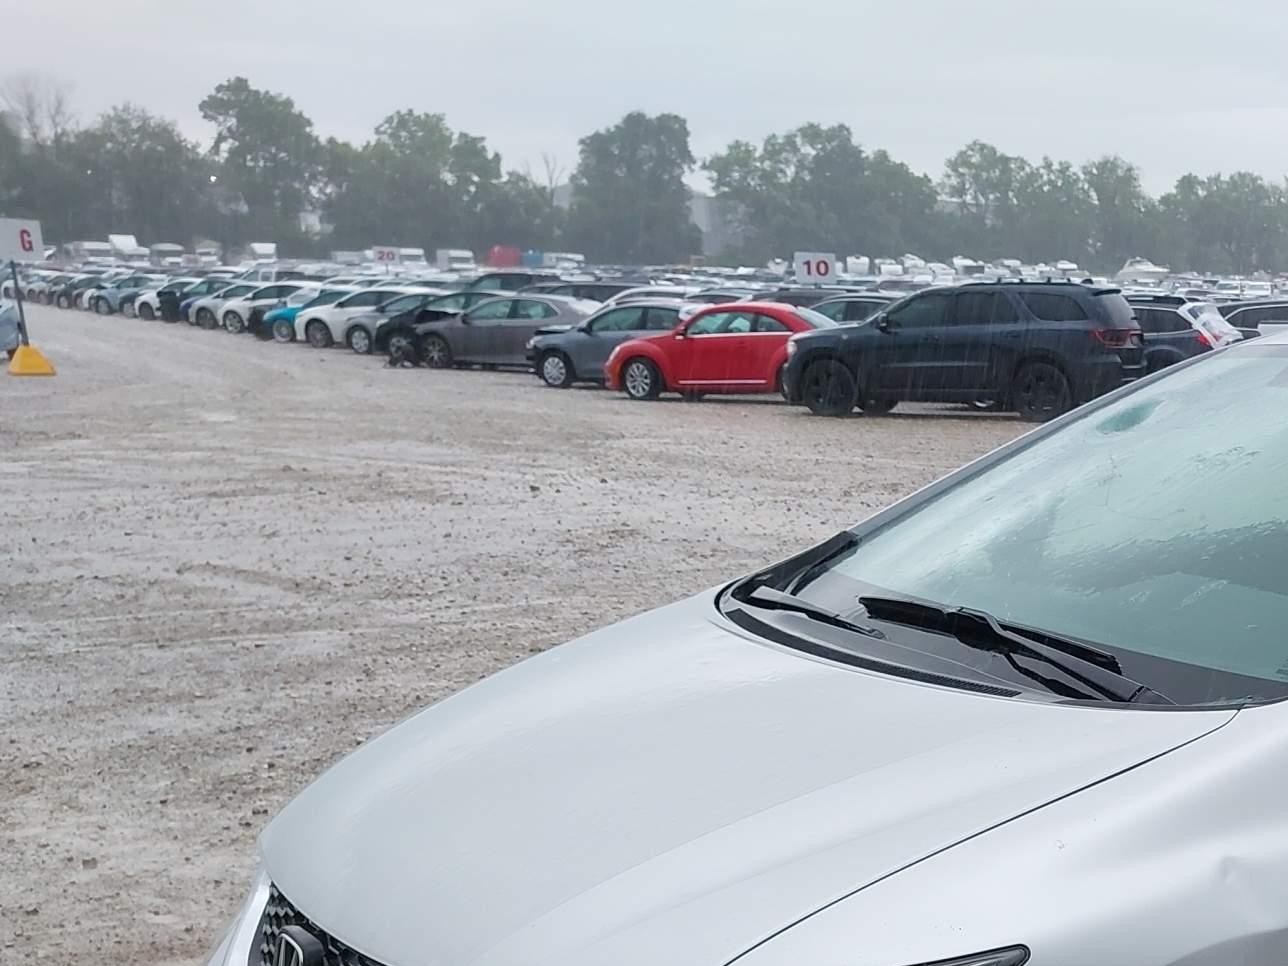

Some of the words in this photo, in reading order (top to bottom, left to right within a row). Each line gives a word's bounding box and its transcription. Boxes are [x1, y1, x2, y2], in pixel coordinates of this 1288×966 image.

[20, 229, 34, 252] G
[377, 250, 396, 262] 20
[803, 259, 829, 277] 10
